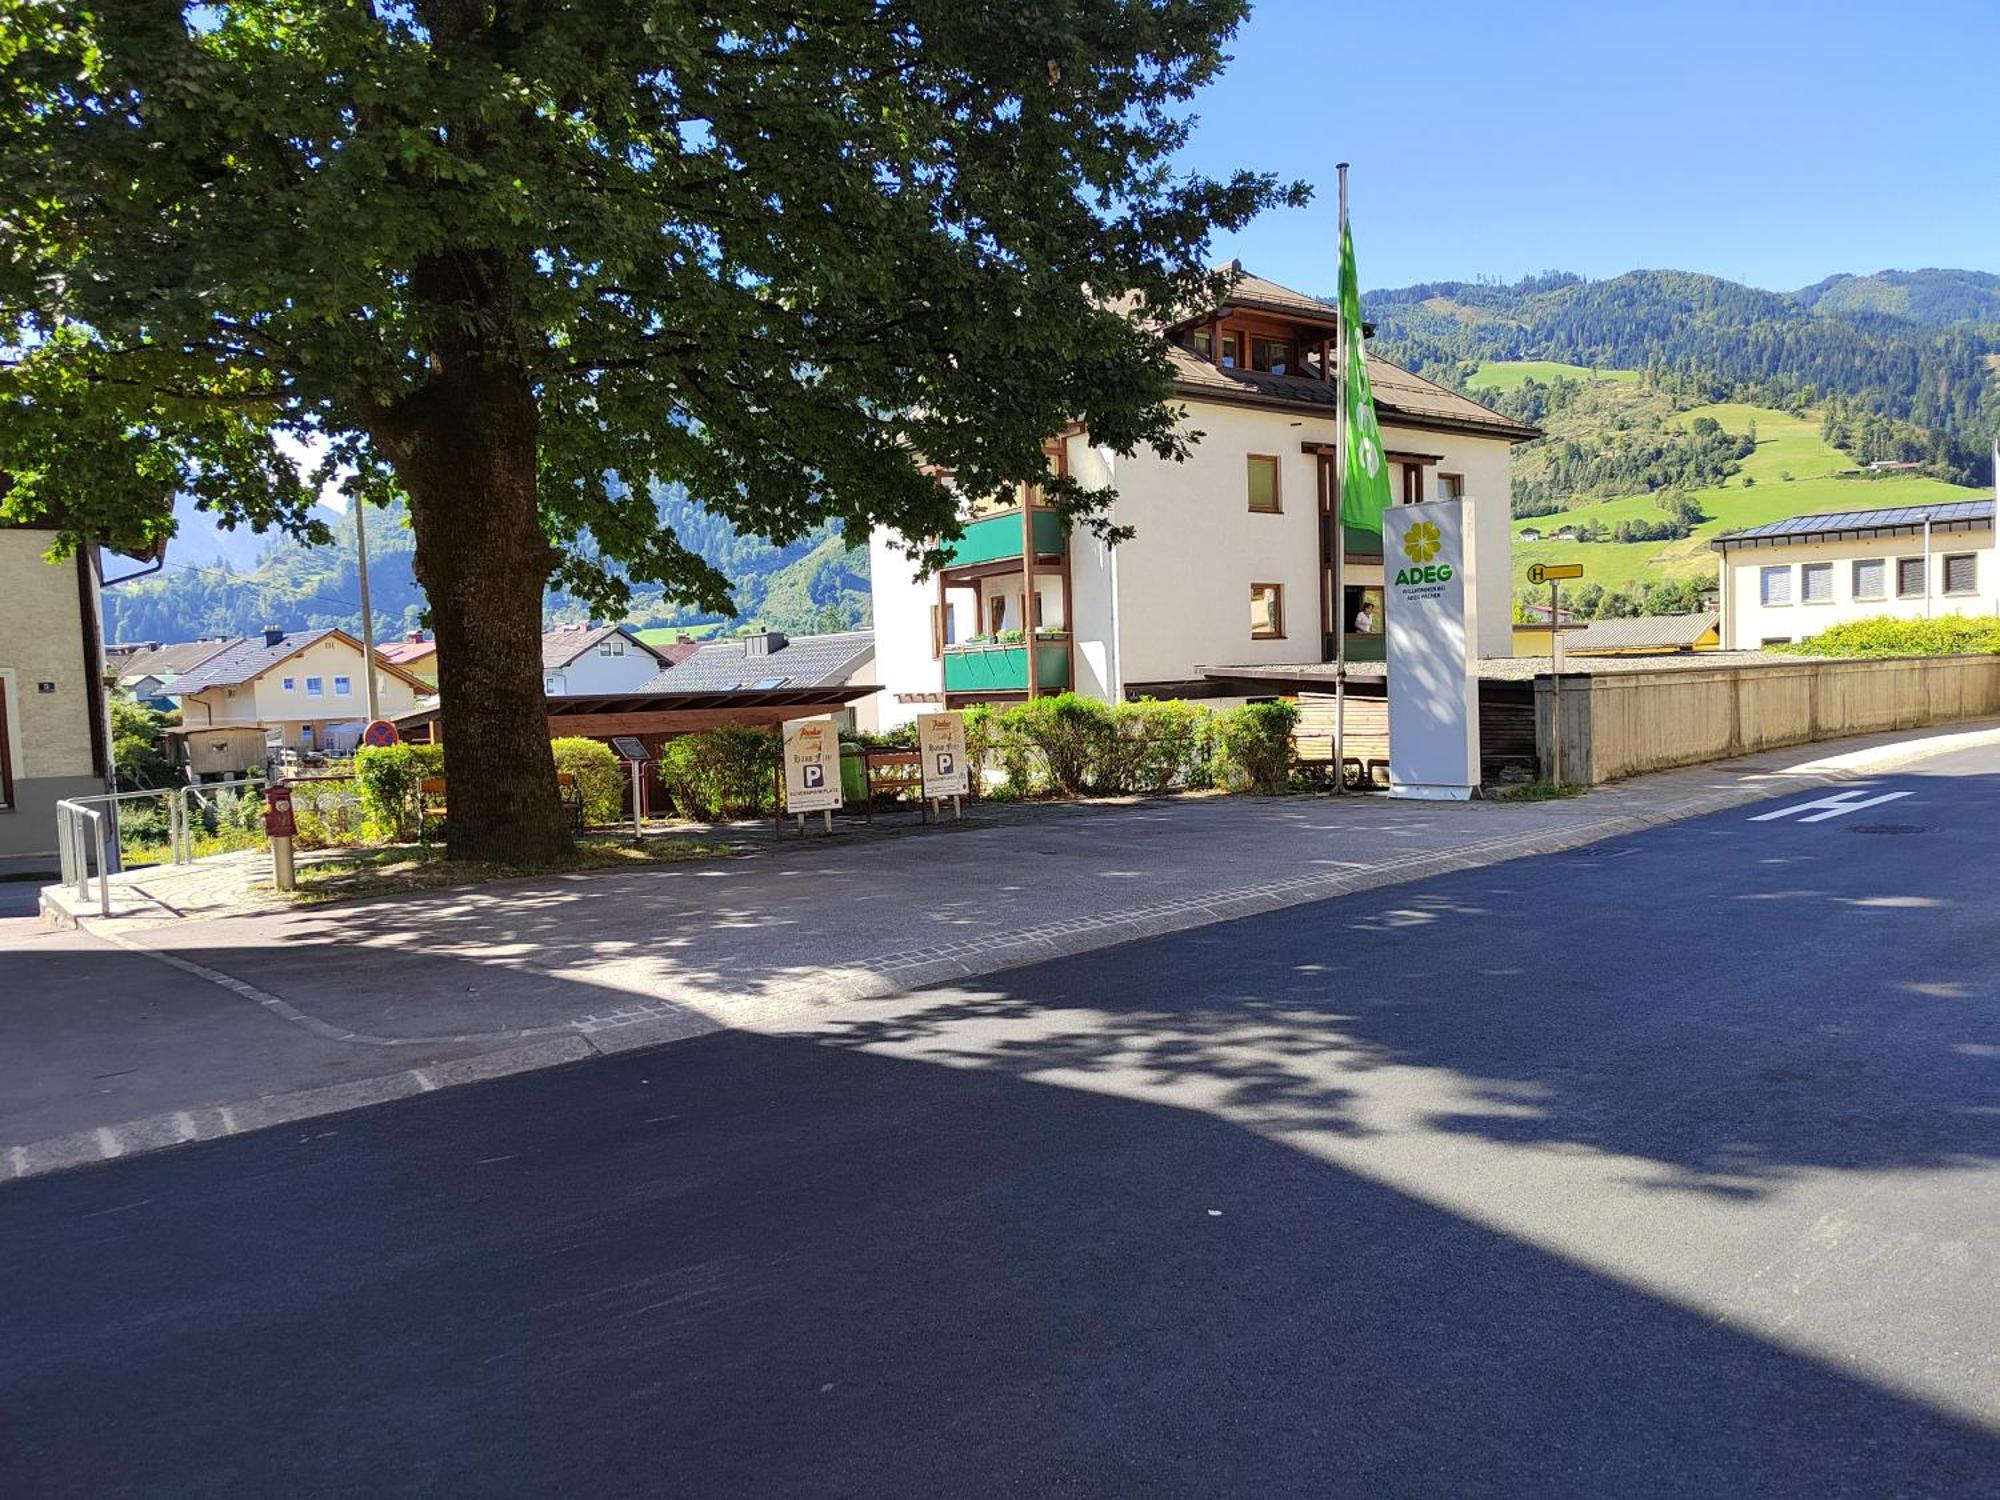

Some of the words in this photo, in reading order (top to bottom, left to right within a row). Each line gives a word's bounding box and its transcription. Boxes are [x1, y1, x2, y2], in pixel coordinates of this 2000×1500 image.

[1395, 564, 1453, 586] ADEG
[1532, 567, 1544, 581] H
[1745, 790, 1917, 822] H
